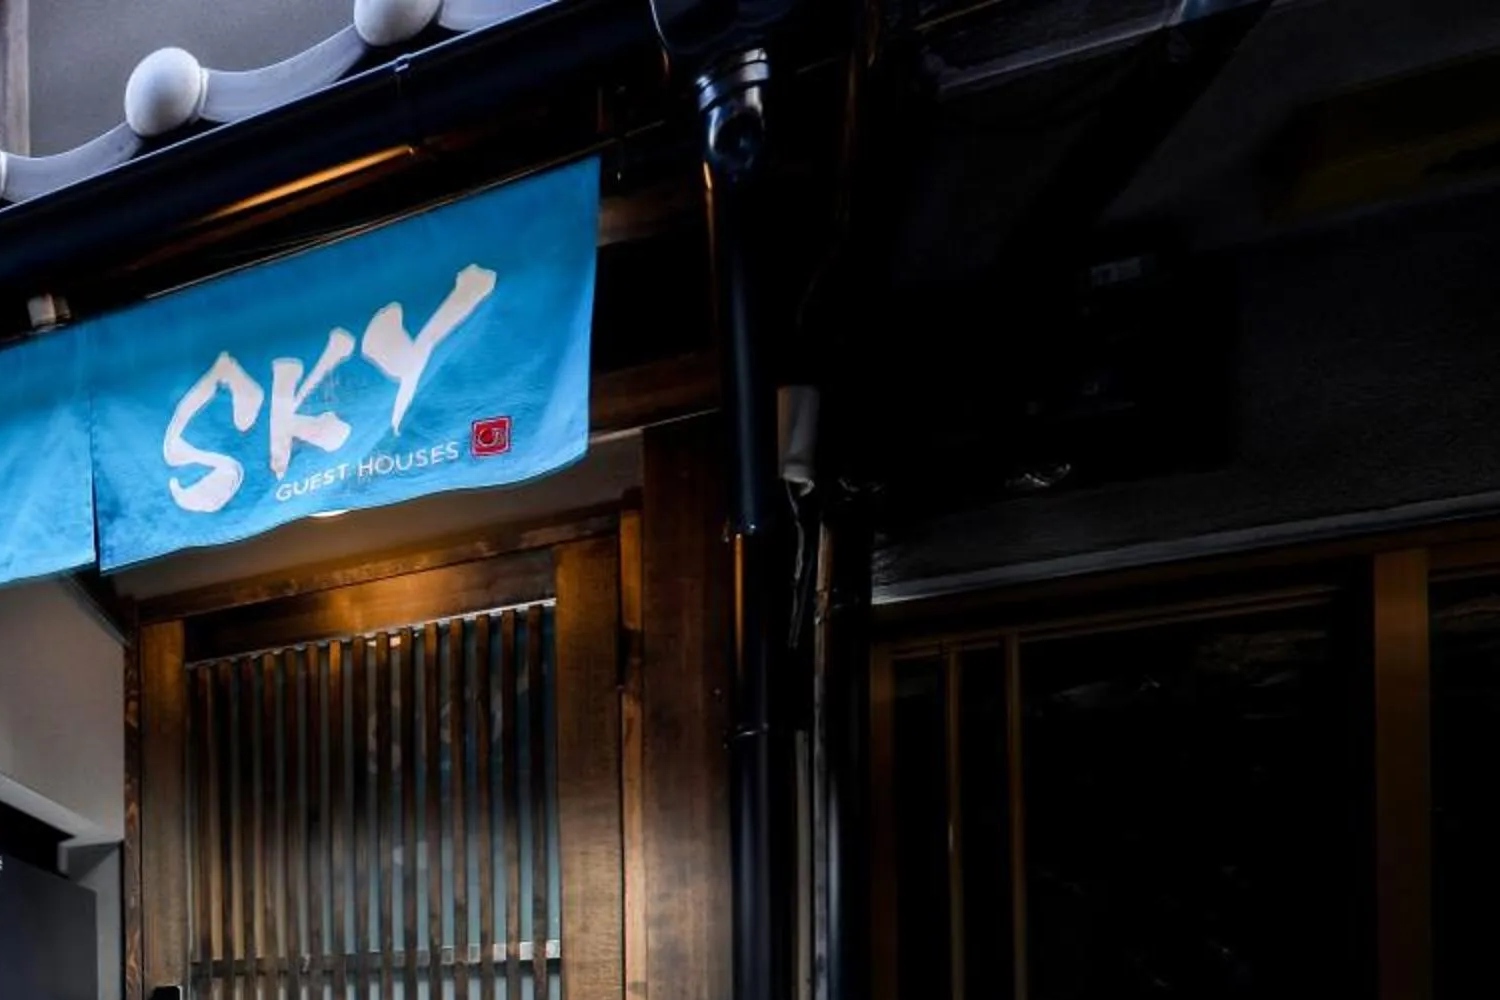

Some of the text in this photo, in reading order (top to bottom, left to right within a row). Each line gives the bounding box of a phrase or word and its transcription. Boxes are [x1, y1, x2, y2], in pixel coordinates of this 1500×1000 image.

[163, 263, 497, 513] SKY
[275, 441, 460, 501] GUEST HOUSES
